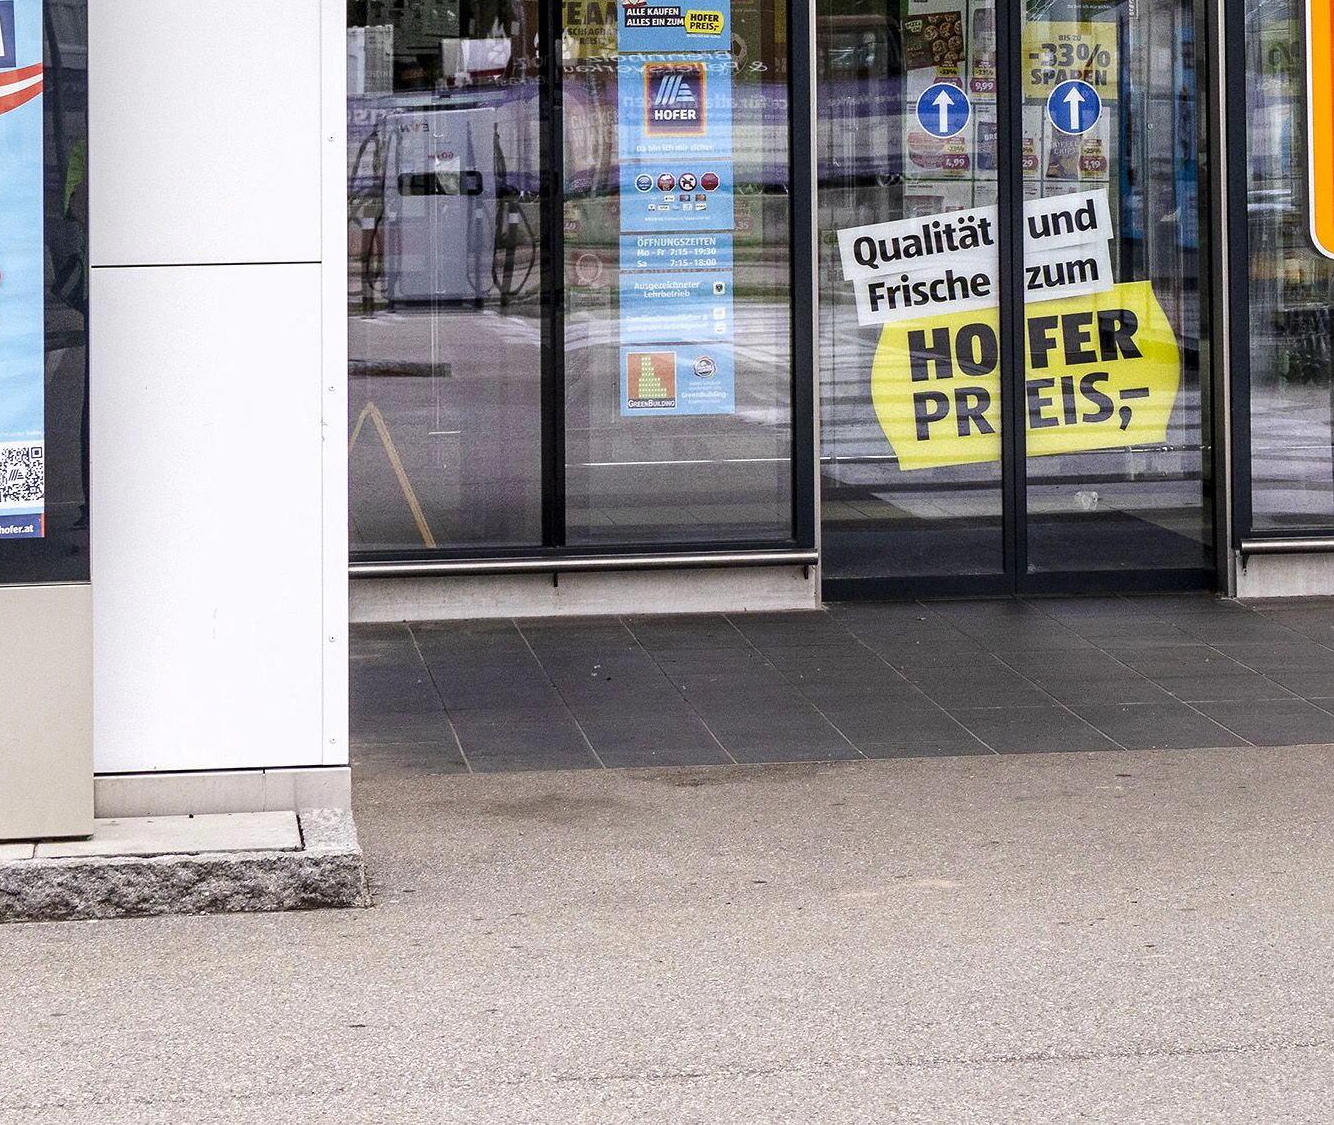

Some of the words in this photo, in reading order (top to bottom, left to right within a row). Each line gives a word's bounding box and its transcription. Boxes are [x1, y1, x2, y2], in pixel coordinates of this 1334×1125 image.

[626, 8, 645, 16] ALLE
[647, 7, 679, 16] KAUFEN
[626, 18, 651, 26] ALLES
[652, 18, 665, 26] EIN
[666, 17, 684, 26] ZUM
[690, 13, 719, 23] HOFER
[689, 22, 719, 31] PREIS,-
[1029, 43, 1111, 68] -33%
[975, 81, 994, 91] 9,99
[654, 109, 697, 121] HOFER
[945, 158, 965, 168] 4,99
[853, 216, 994, 269] Qualität
[1028, 199, 1098, 240] und
[637, 236, 716, 247] ÖFFNUNGSZEITEN
[637, 249, 649, 257] Mo
[656, 248, 665, 256] Fr
[637, 260, 647, 268] Sa
[868, 269, 991, 313] Frische
[1025, 257, 1099, 291] zum
[643, 290, 690, 299] Lehrbetrieb
[907, 308, 1143, 383] HOFER
